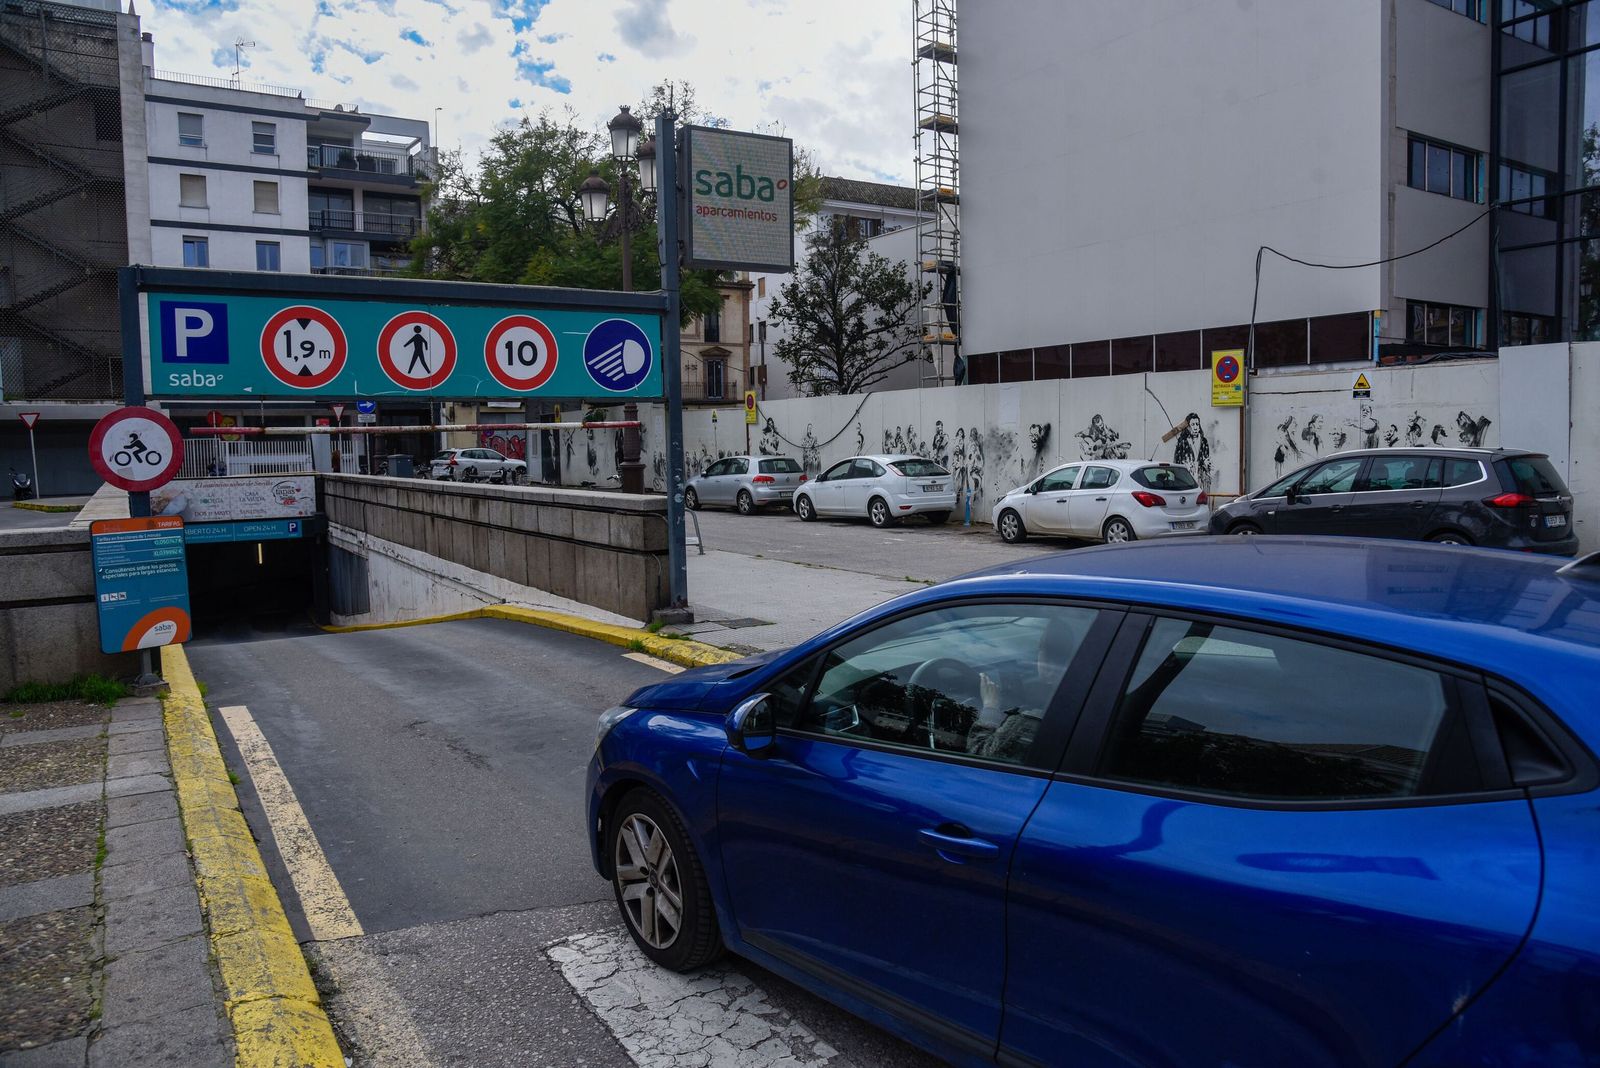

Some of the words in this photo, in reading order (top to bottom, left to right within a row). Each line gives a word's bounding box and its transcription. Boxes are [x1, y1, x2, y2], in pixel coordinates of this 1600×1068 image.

[696, 205, 778, 222] aparcamientos
[175, 307, 214, 357] P
[283, 329, 315, 362] 1,9
[319, 349, 331, 359] m
[505, 340, 538, 366] 10
[158, 520, 181, 528] TARIFAS
[289, 522, 297, 532] P
[154, 624, 172, 632] saba
